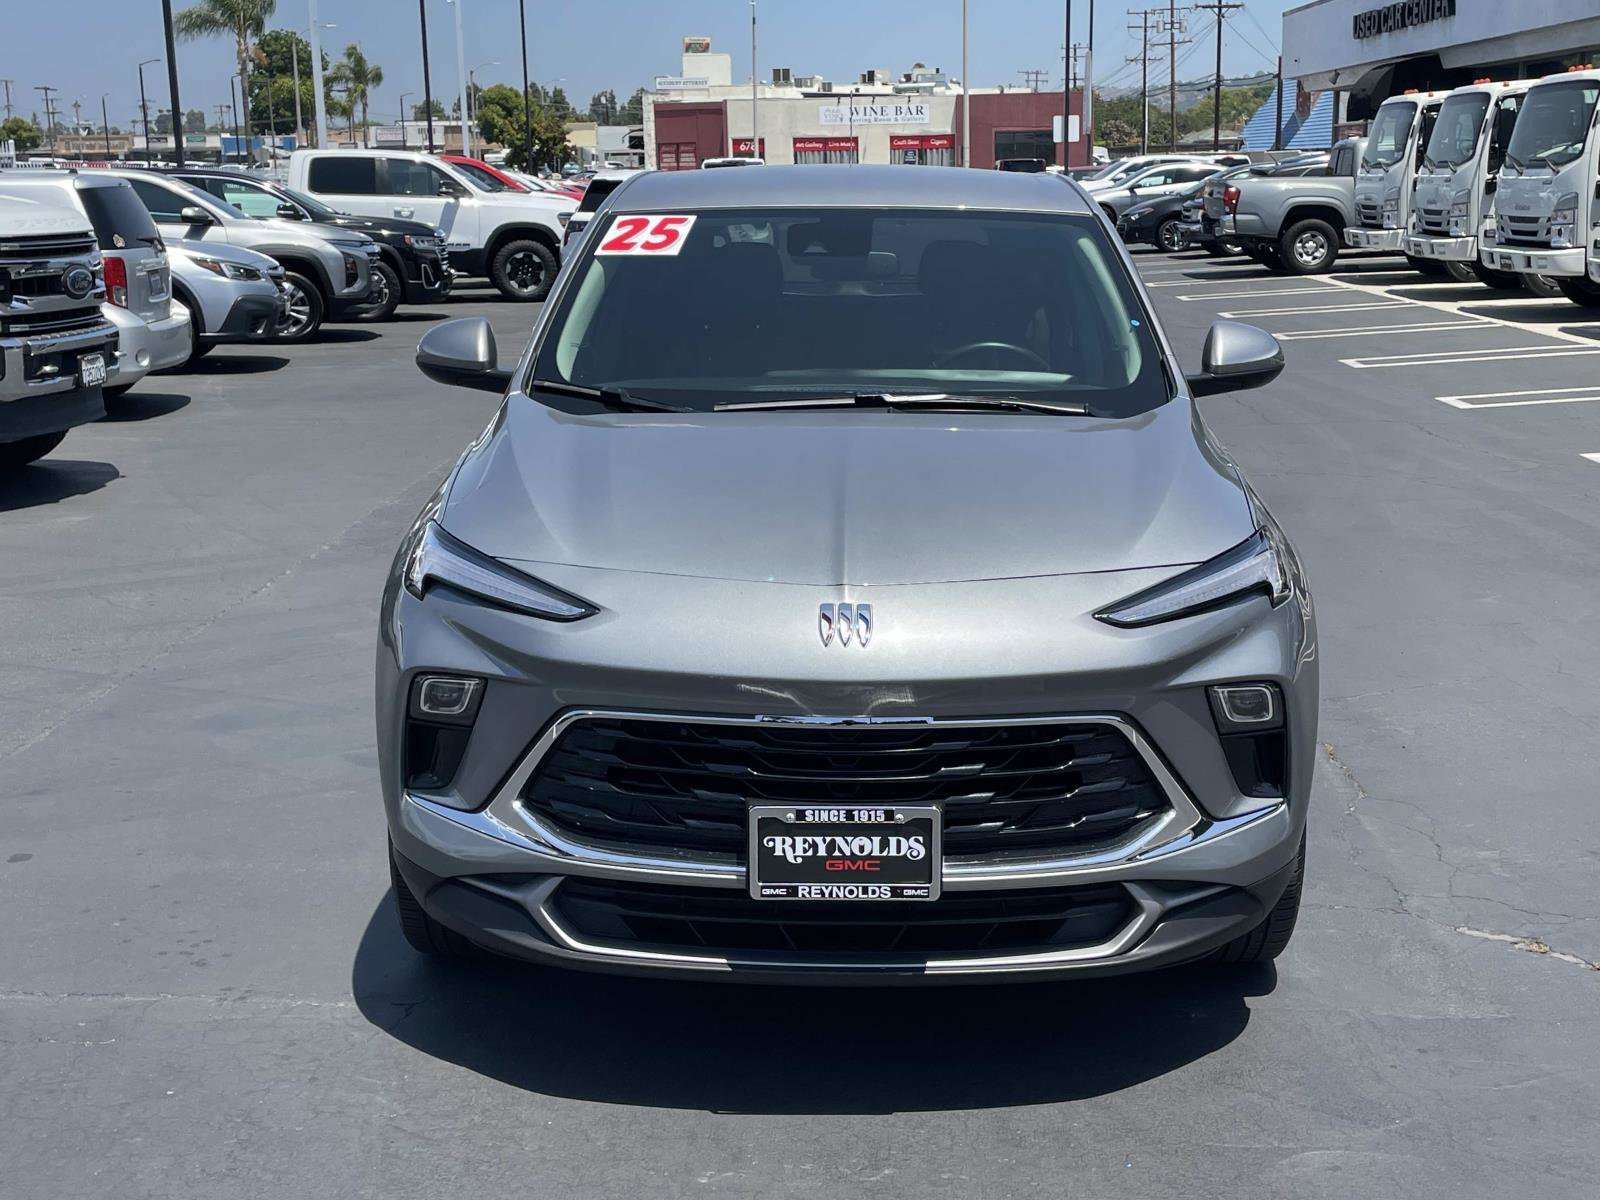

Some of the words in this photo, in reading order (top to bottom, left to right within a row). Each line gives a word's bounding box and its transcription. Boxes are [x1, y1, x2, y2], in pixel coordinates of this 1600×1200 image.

[1353, 9, 1381, 40] USED
[1380, 4, 1405, 33] CAR
[1404, 0, 1456, 28] CENTER
[849, 105, 889, 117] WINE
[894, 104, 925, 116] BAR
[600, 217, 690, 252] 25
[805, 809, 847, 822] SINCE
[852, 809, 885, 822] 1915
[763, 835, 926, 864] REYNOLDS
[825, 859, 881, 871] GMC
[798, 886, 891, 898] REYNOLDS
